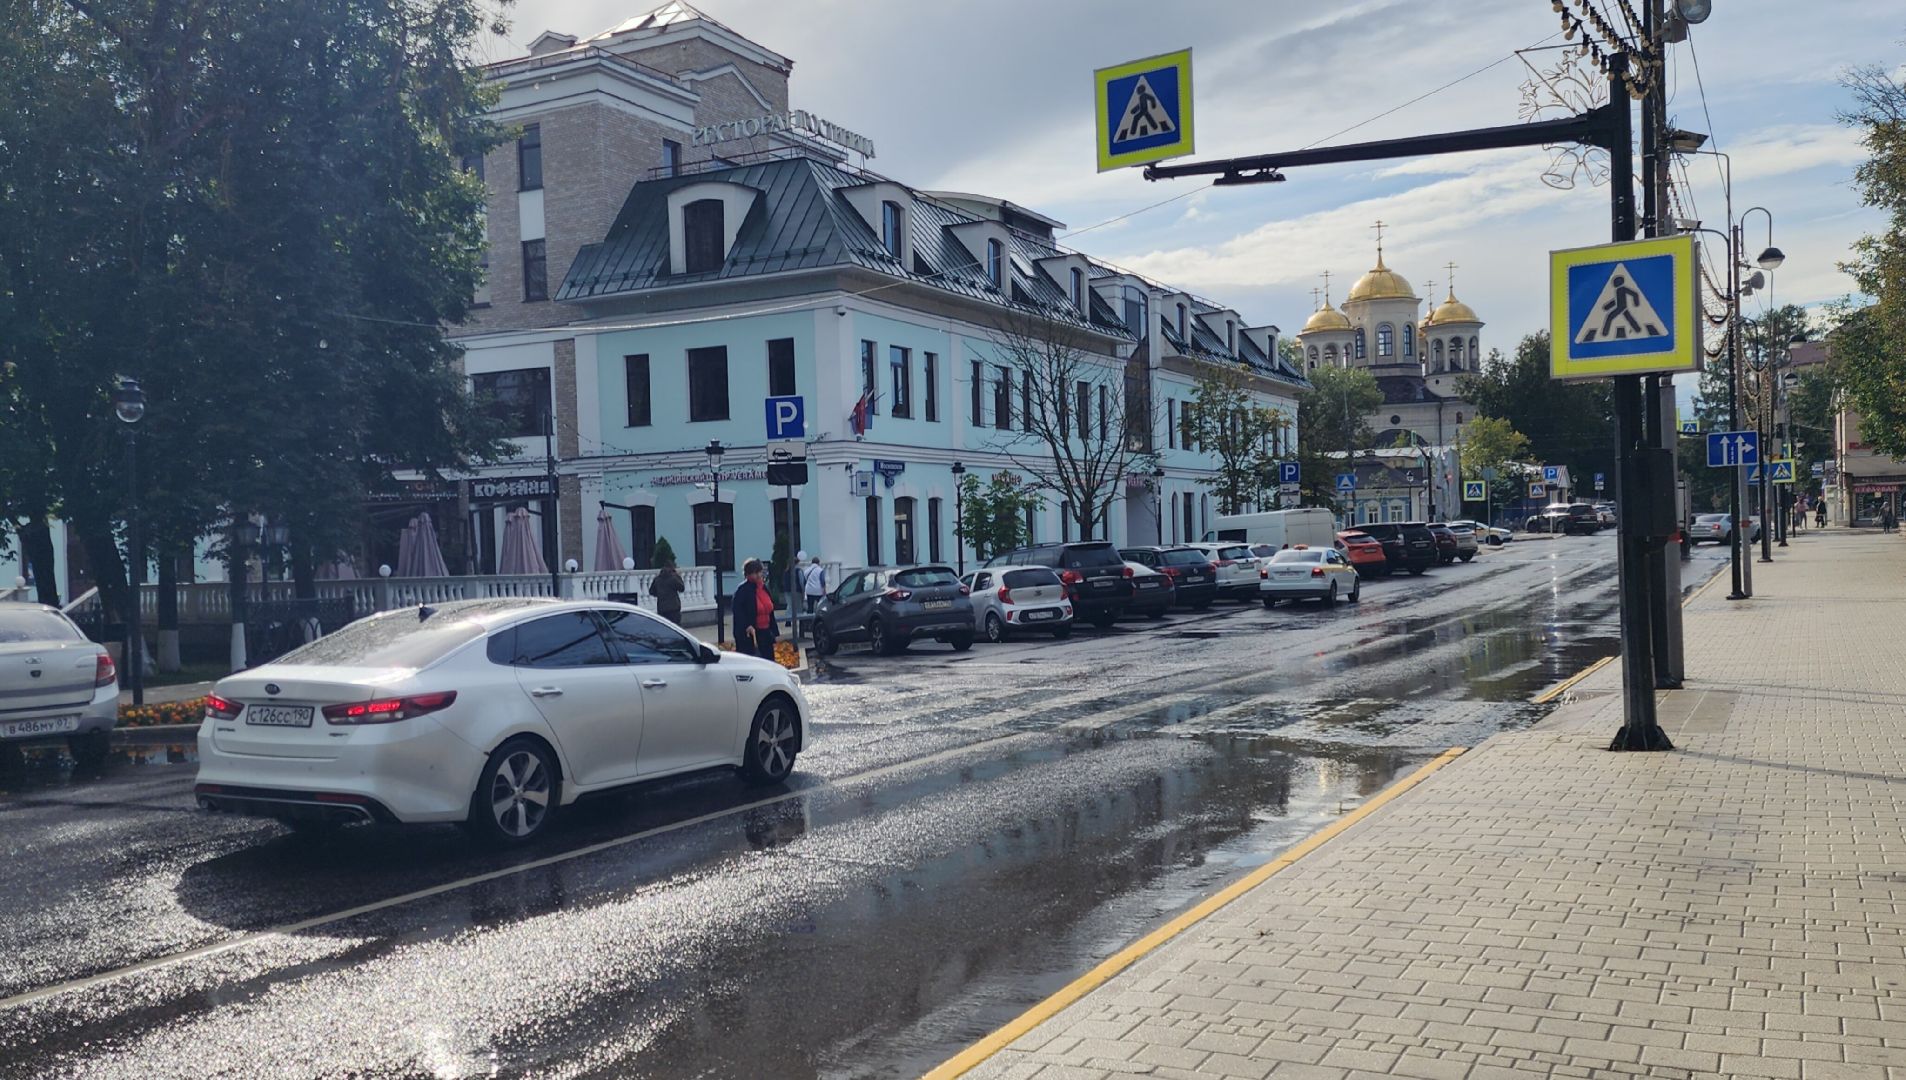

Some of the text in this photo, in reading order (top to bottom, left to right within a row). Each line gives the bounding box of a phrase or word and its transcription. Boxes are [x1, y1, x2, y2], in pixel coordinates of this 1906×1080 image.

[775, 401, 798, 435] P
[1285, 464, 1297, 481] P
[1547, 468, 1556, 479] P
[474, 479, 550, 497] КОФЕЙНЯ
